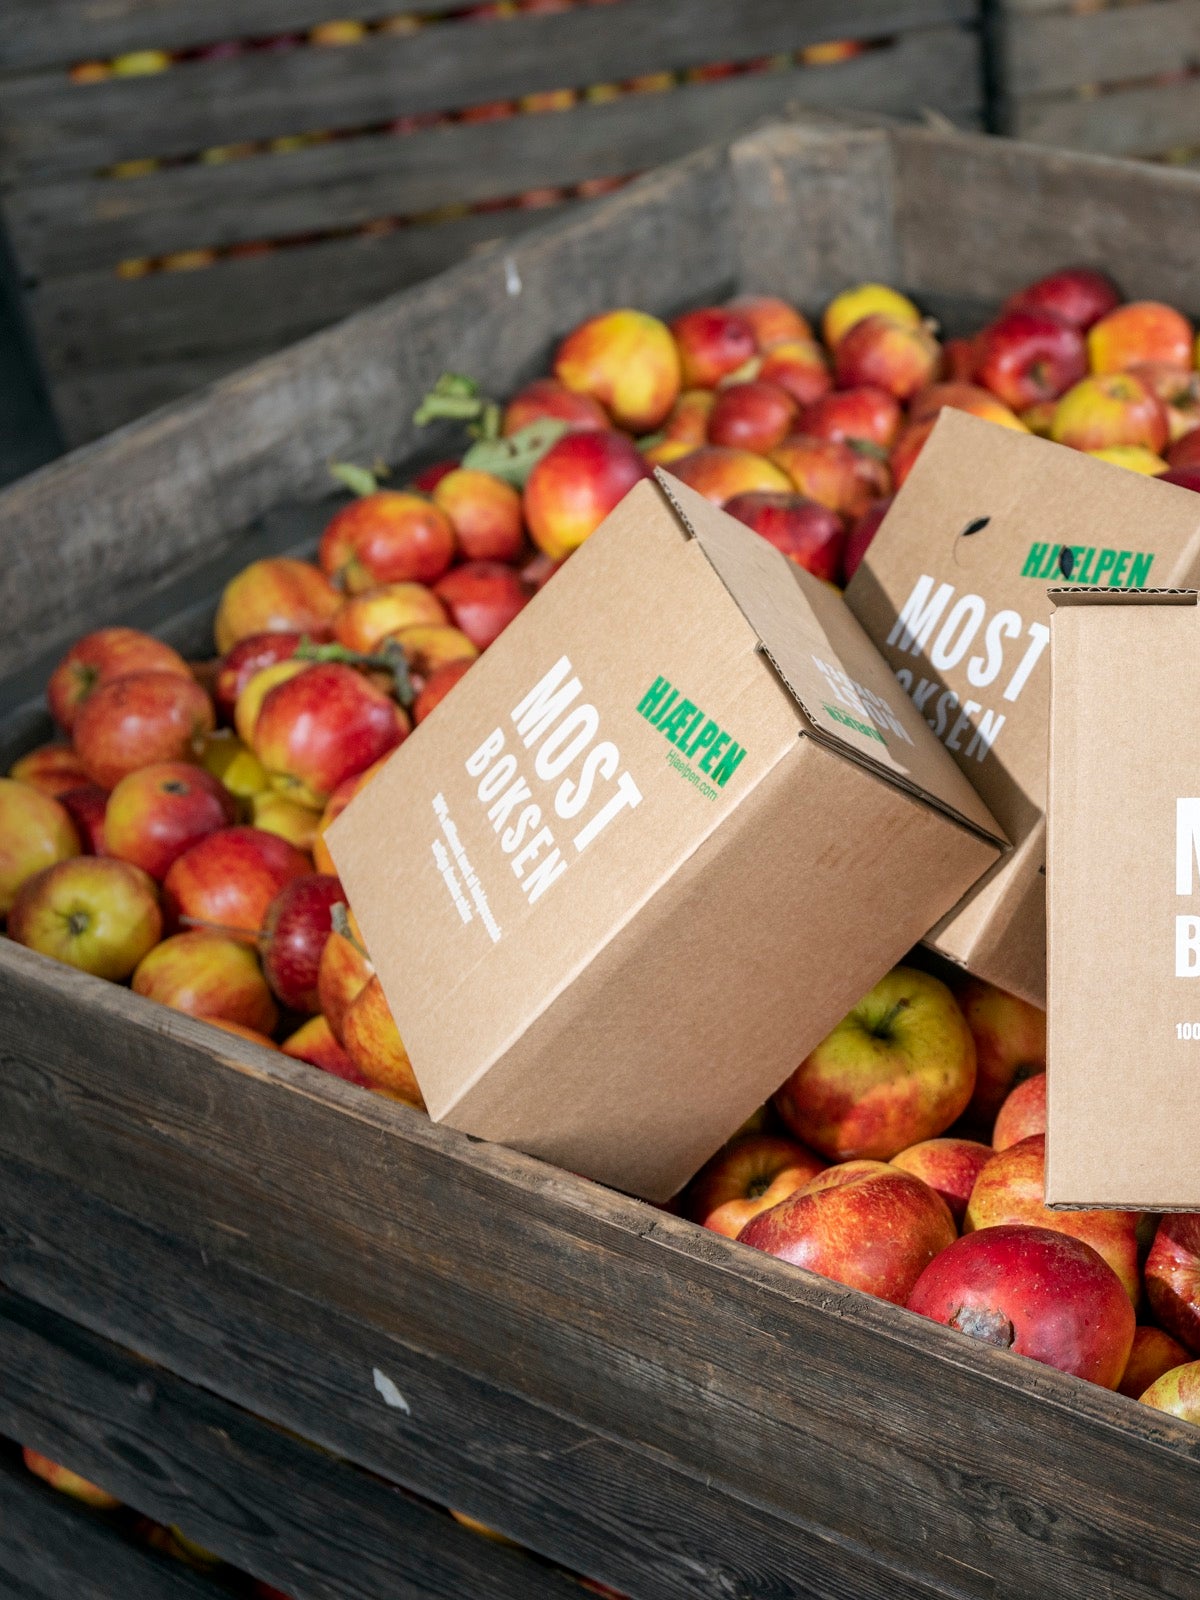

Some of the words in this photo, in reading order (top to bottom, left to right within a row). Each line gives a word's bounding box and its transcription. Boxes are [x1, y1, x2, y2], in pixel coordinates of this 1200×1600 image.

[886, 574, 1050, 702] MOST
[510, 655, 643, 853] MOST
[636, 675, 747, 789] HJÆLPEN
[665, 748, 718, 802] Hjaelpen.com
[465, 727, 568, 905] BOKSEN
